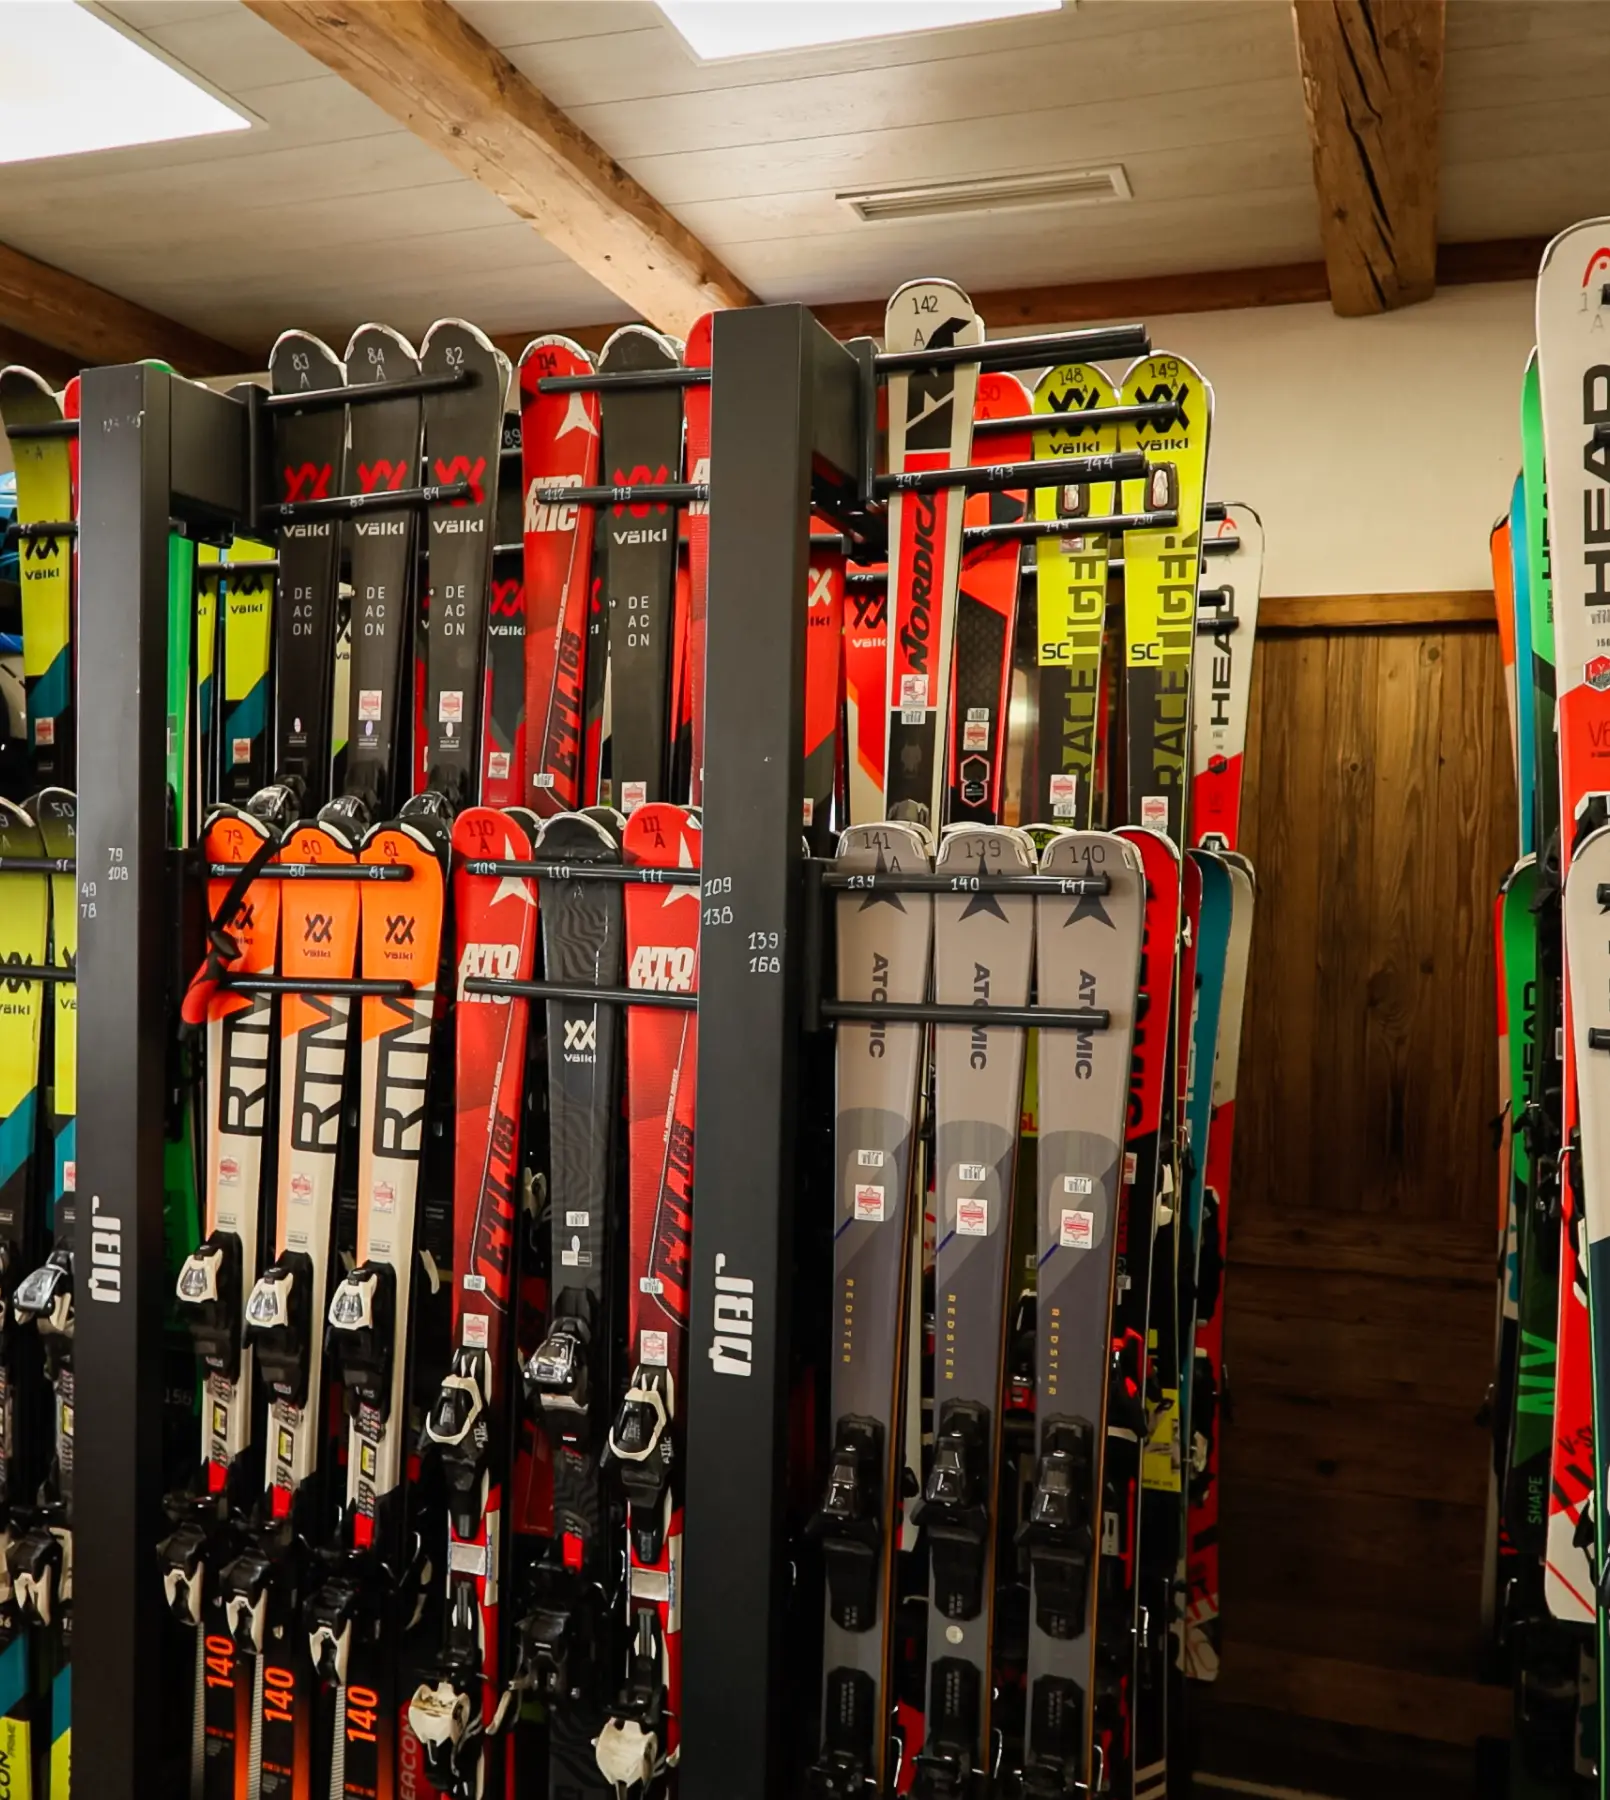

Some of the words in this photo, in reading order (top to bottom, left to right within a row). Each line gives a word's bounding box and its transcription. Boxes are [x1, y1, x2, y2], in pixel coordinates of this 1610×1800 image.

[912, 296, 939, 315] 142
[292, 353, 309, 370] 83
[367, 347, 385, 364] 84
[445, 346, 464, 364] 82
[1058, 367, 1085, 386] 148
[1149, 361, 1179, 379] 149
[1050, 441, 1101, 455] Völkl
[1136, 437, 1189, 452] Völkl
[283, 523, 330, 538] Völkl
[355, 522, 405, 537] Völkl
[433, 519, 484, 534] Völkl
[613, 528, 667, 545] Völkl
[24, 569, 60, 581] Völkl
[366, 586, 386, 599] DE
[445, 585, 466, 599] DE
[901, 493, 938, 675] NORDIC
[294, 587, 313, 600] DE
[293, 605, 313, 617] AC
[365, 604, 386, 617] AC
[444, 604, 466, 617] AC
[627, 596, 650, 609] DE
[292, 623, 313, 636] ON
[364, 623, 386, 636] ON
[444, 623, 466, 636] ON
[627, 615, 650, 628] AC
[627, 633, 650, 647] ON
[852, 637, 888, 648] Völk
[1041, 643, 1071, 660] SC
[1131, 643, 1160, 661] SC
[864, 832, 891, 849] 141
[965, 839, 1001, 859] 139
[108, 847, 124, 862] 79
[1070, 845, 1106, 864] 140
[108, 865, 129, 881] 108
[81, 882, 97, 898] 49
[704, 876, 733, 897] 109
[847, 875, 876, 890] 139
[950, 877, 980, 892] 140
[81, 902, 97, 919] 78
[703, 905, 734, 926] 138
[747, 931, 779, 950] 139
[749, 956, 781, 974] 168
[1074, 969, 1097, 1081] ATMIC
[291, 994, 349, 1154] RTM
[373, 996, 433, 1160] RTM
[945, 1294, 956, 1380] REDSTER
[1048, 1308, 1060, 1395] REDSTER
[205, 1635, 235, 1689] 140
[264, 1665, 295, 1723] 140
[347, 1685, 379, 1743] 140
